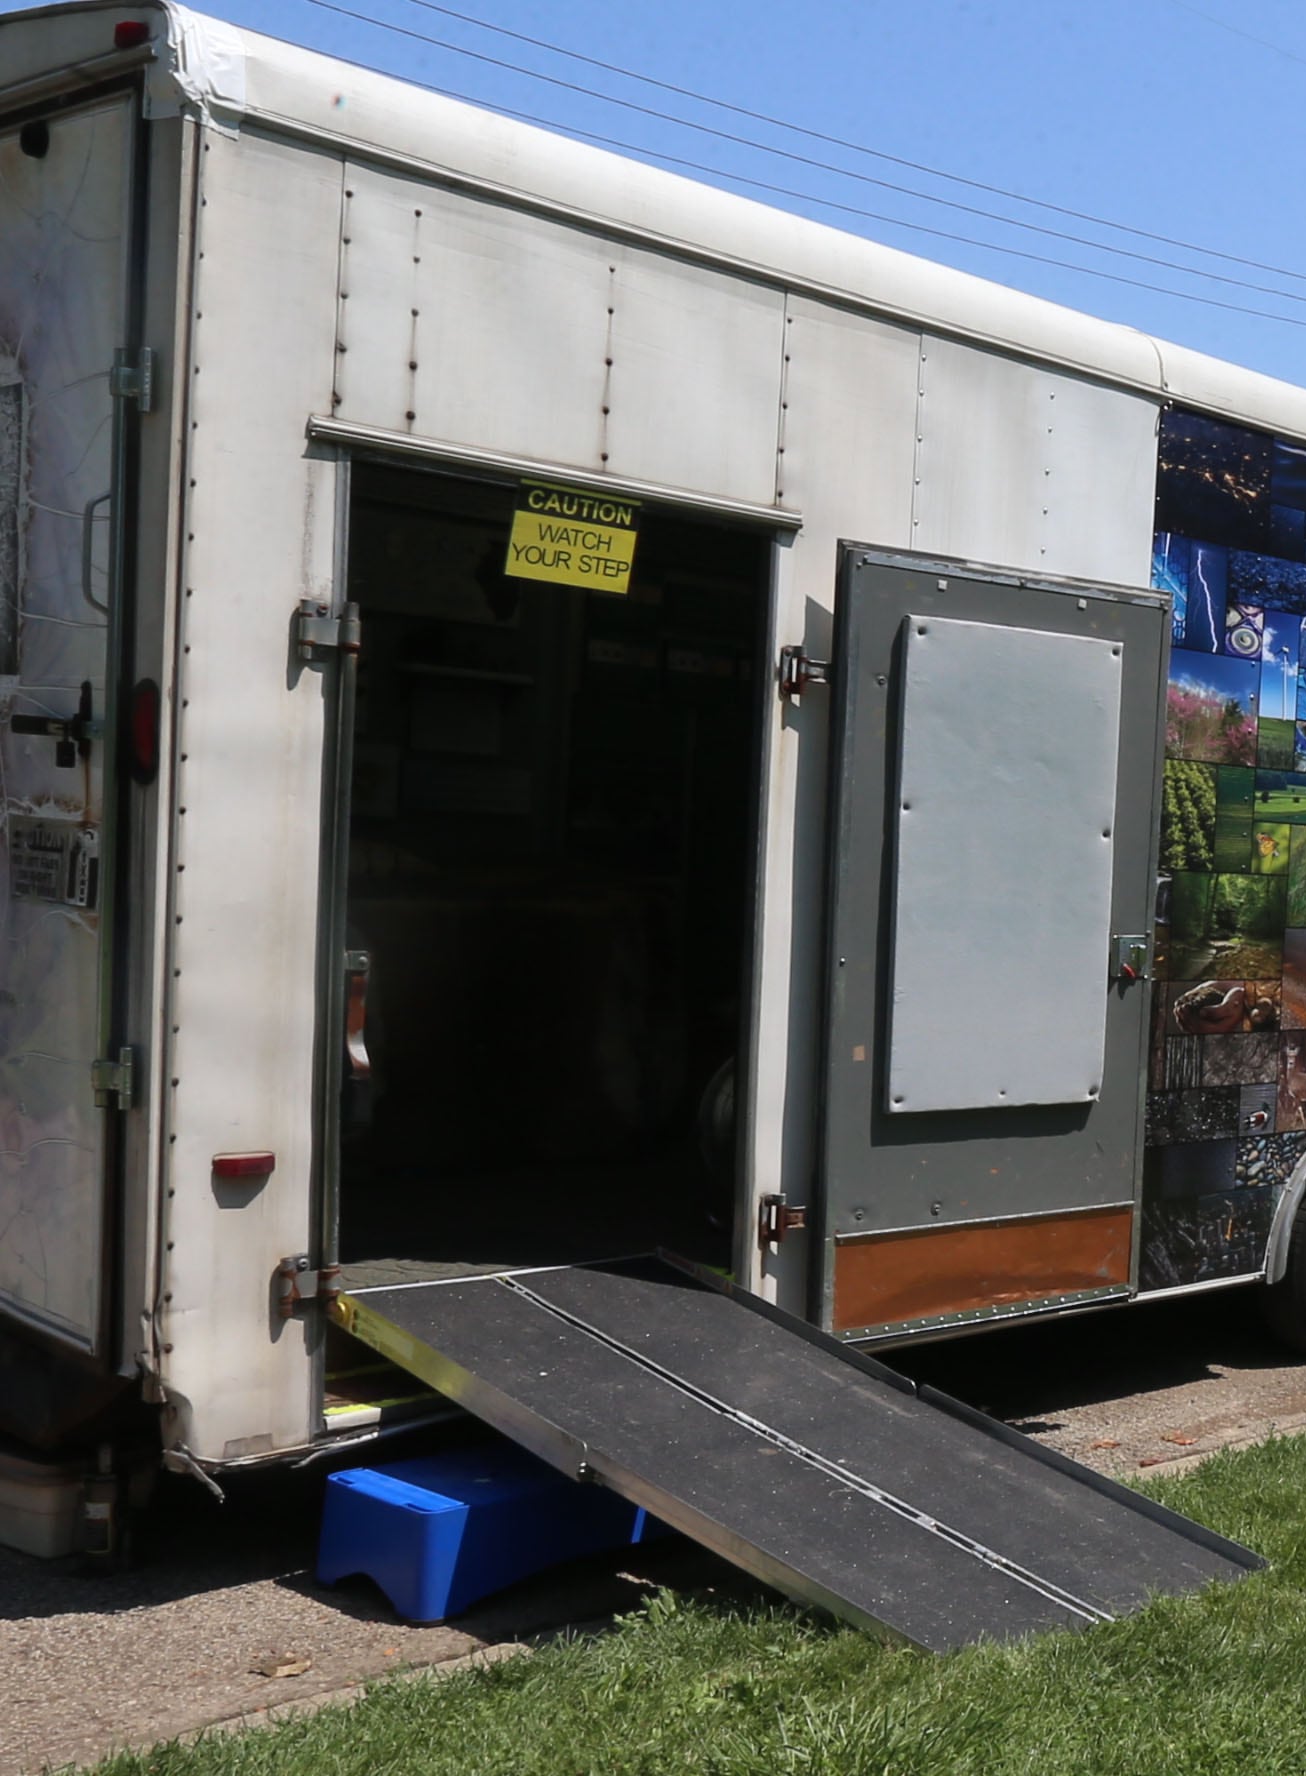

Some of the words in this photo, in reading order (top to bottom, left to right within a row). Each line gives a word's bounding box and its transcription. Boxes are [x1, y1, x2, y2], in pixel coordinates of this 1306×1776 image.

[528, 490, 633, 526] CAUTION
[539, 522, 612, 553] WATCH
[512, 542, 572, 570] YOUR
[578, 554, 630, 578] STEP
